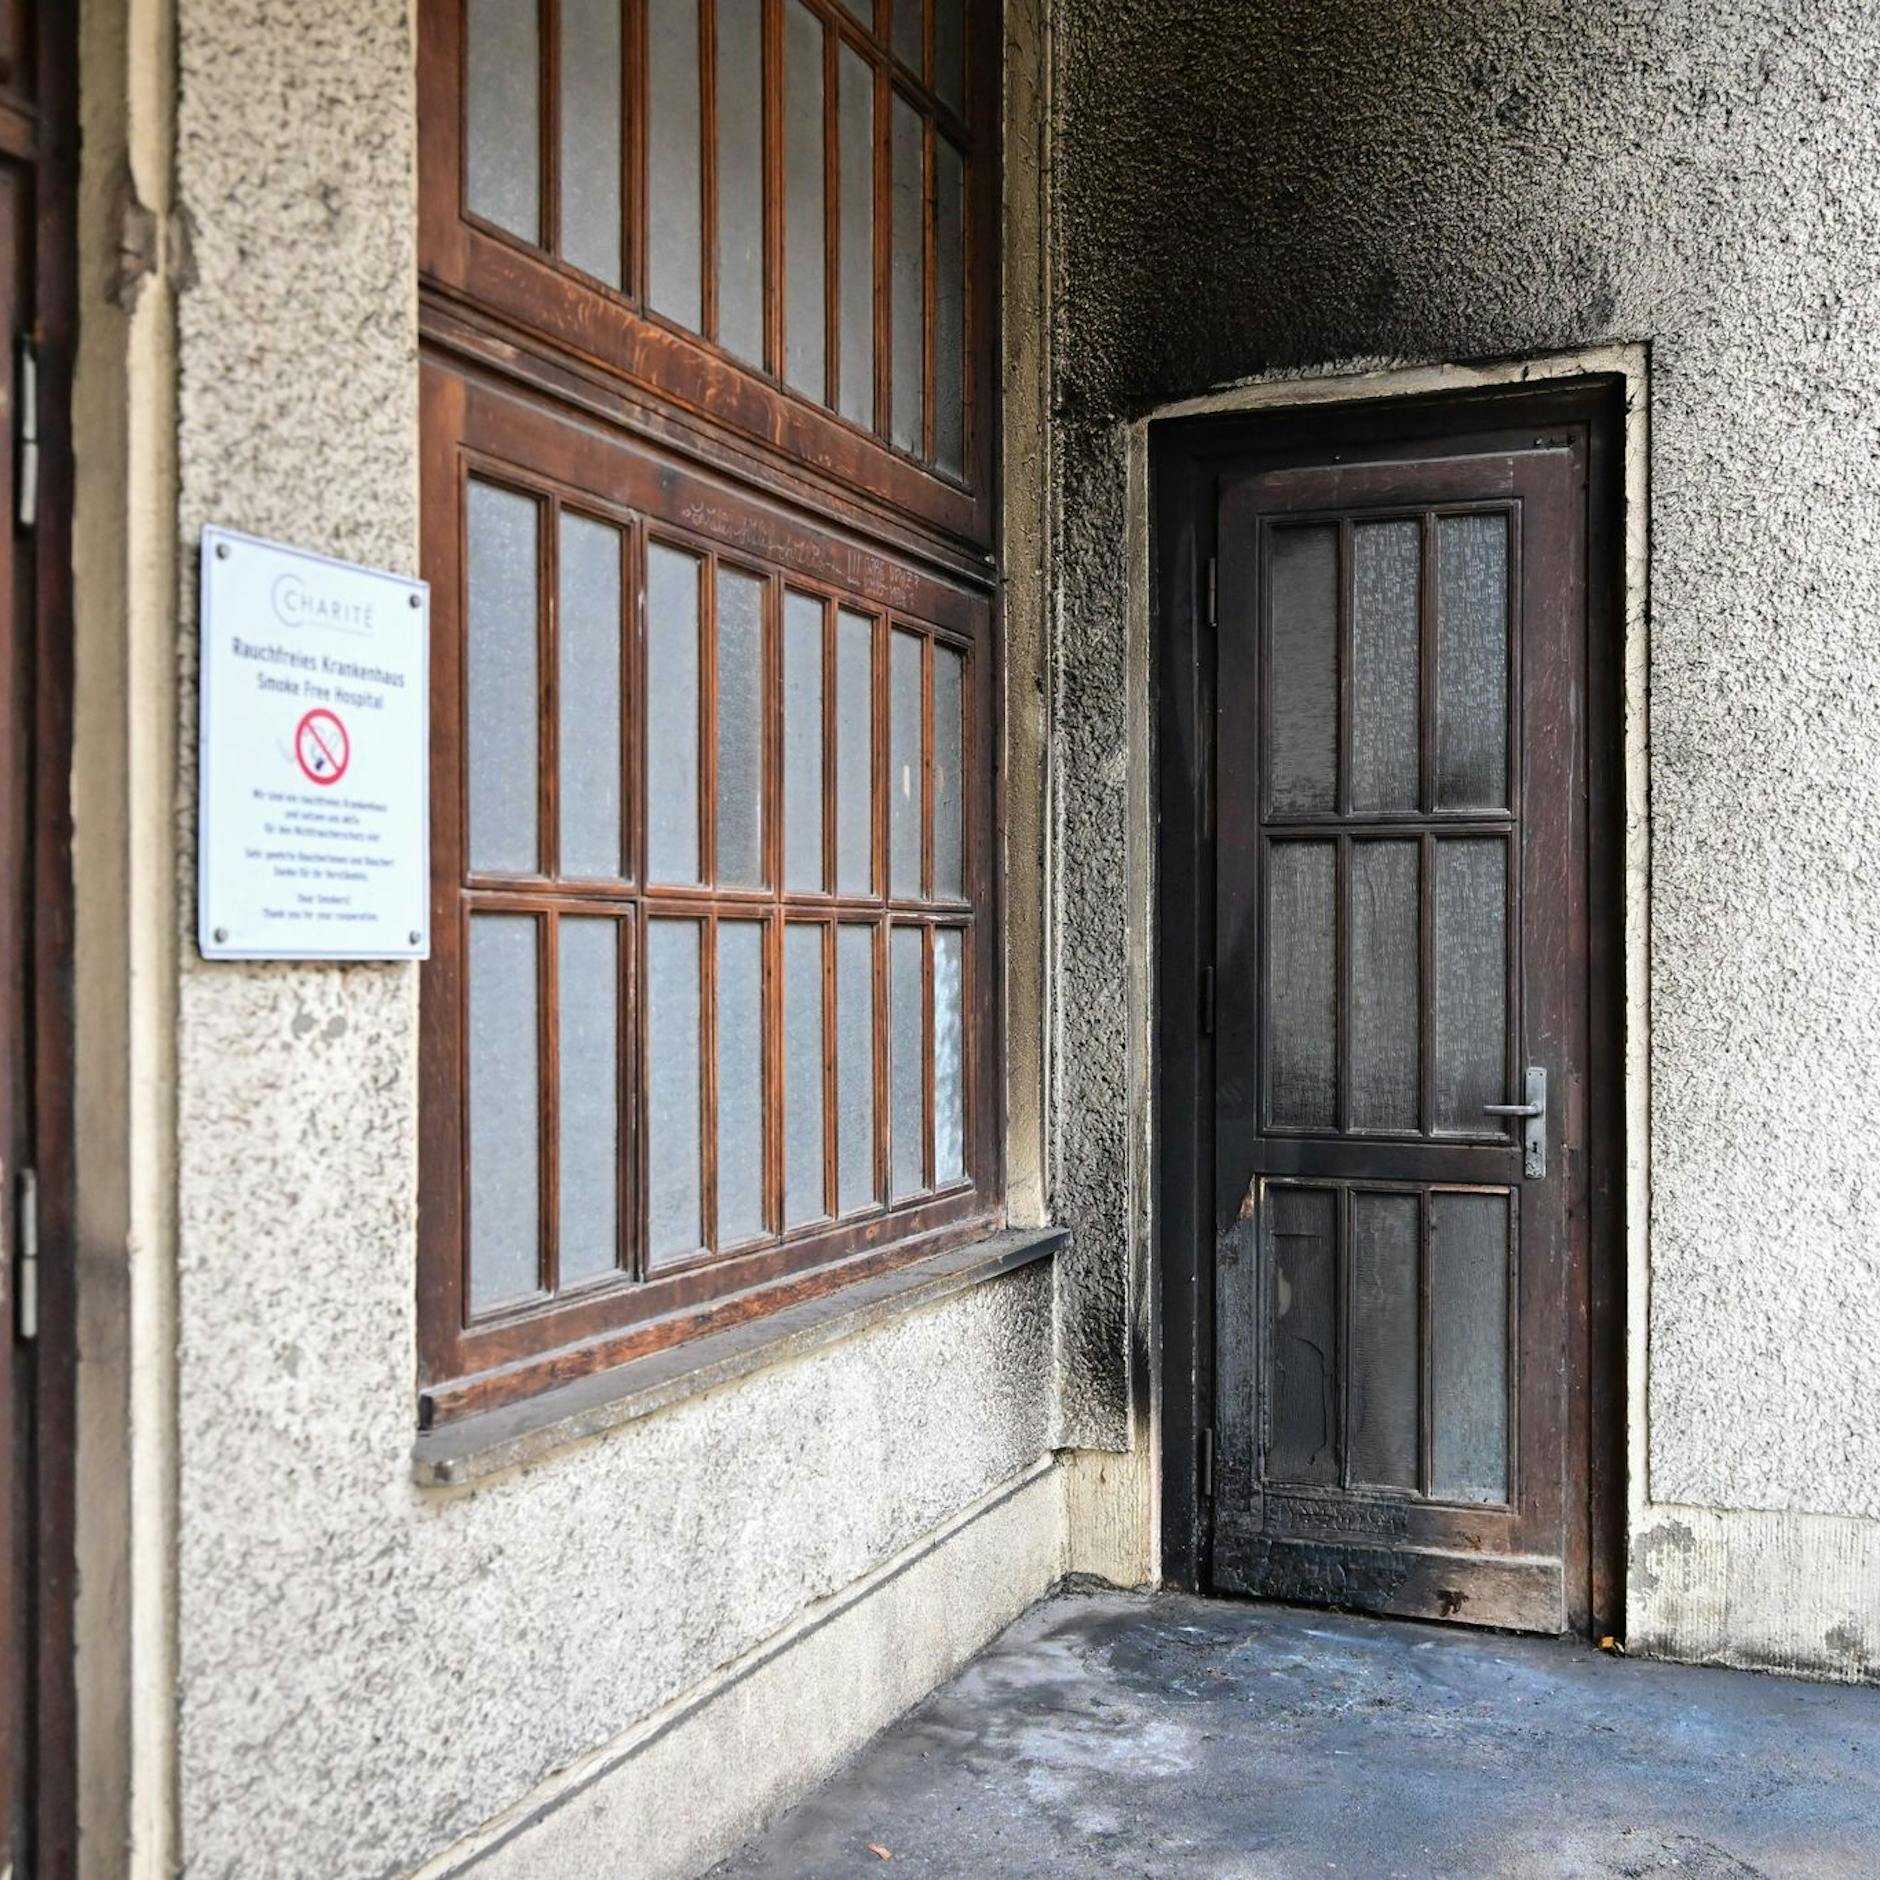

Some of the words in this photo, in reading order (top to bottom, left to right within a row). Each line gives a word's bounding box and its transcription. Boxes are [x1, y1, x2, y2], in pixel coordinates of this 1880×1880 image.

[232, 636, 317, 671] Rauchfreies
[322, 656, 405, 689] Krankenhaus
[257, 672, 299, 696] Smoke
[304, 680, 330, 701] Free
[334, 687, 384, 710] Hospital
